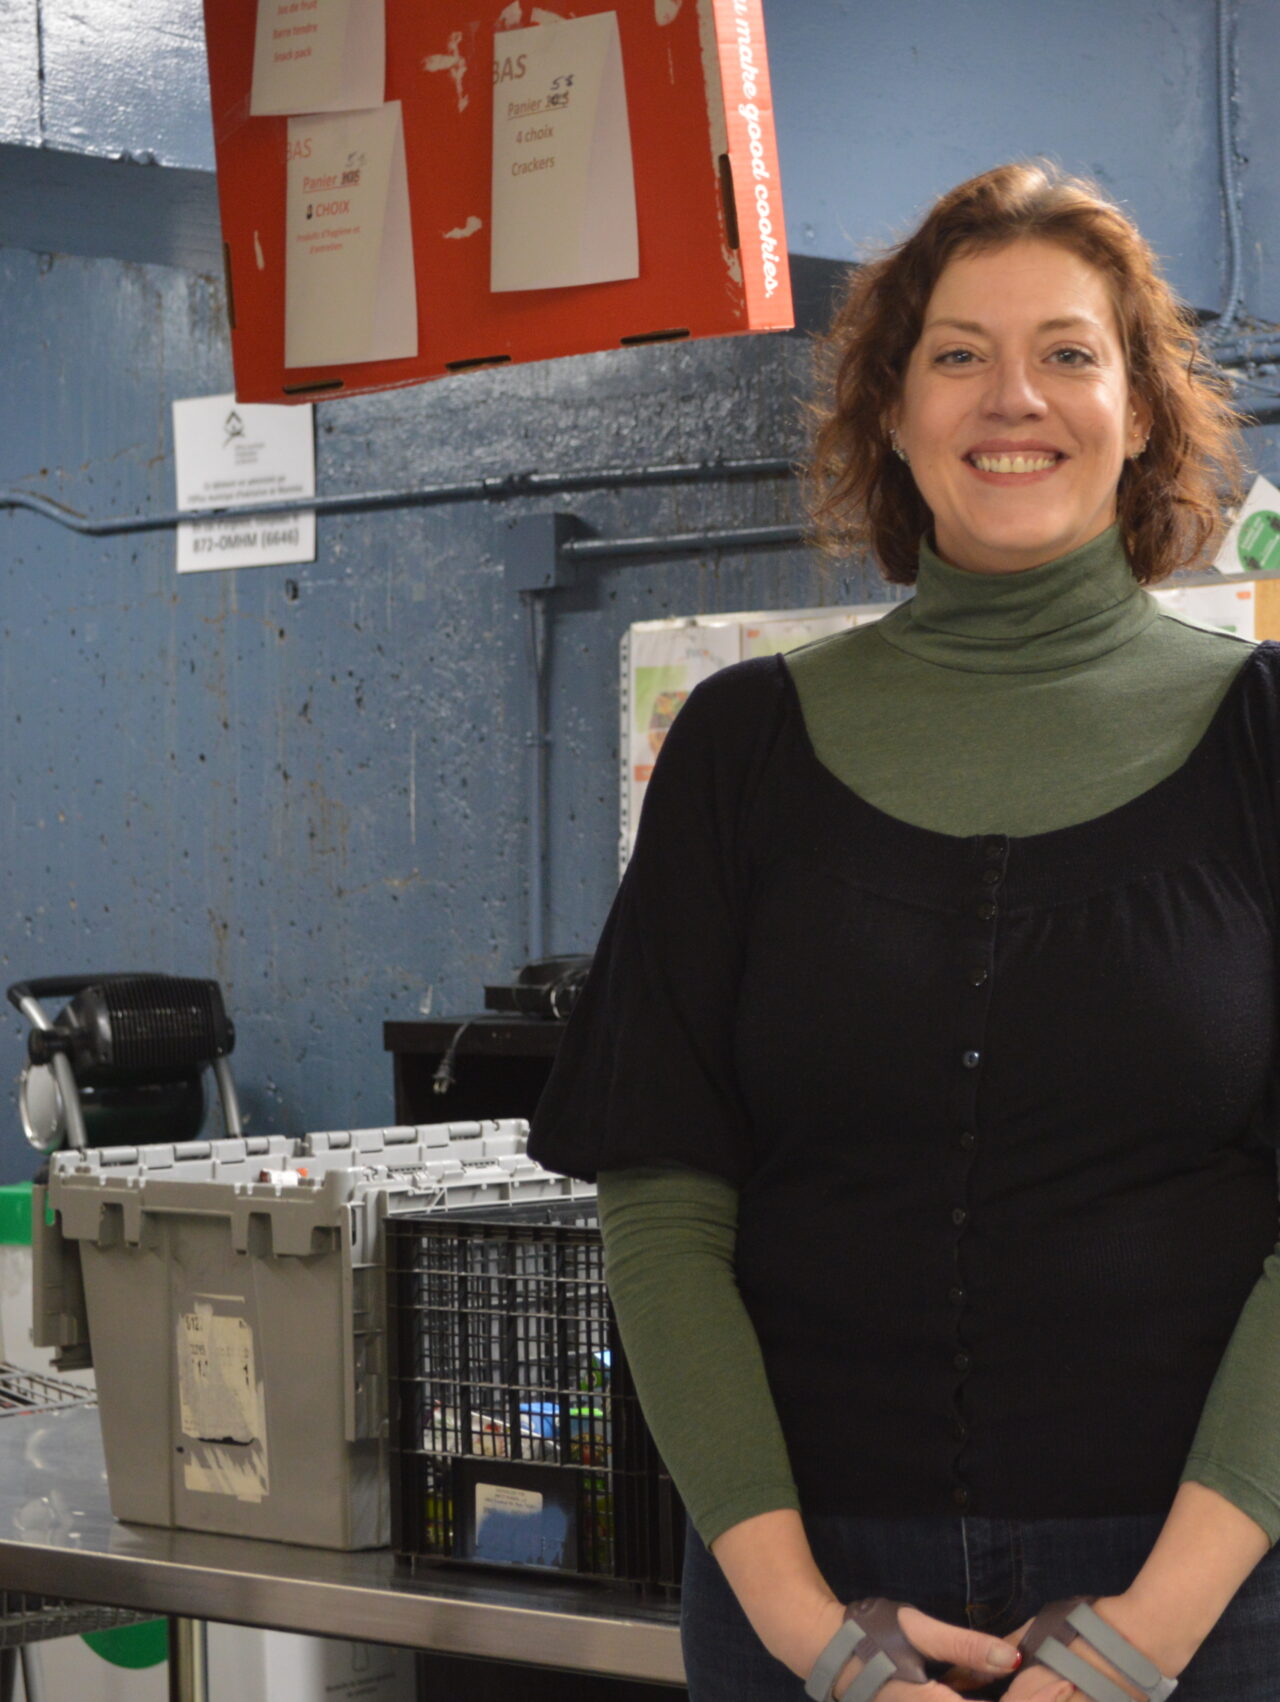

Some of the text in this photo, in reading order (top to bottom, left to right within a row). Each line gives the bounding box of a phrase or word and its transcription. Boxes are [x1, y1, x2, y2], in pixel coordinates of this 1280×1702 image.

[736, 18, 760, 98] make
[507, 99, 542, 116] Panier
[525, 125, 555, 142] choix
[738, 104, 771, 181] good
[511, 156, 556, 176] Crackers
[303, 173, 337, 191] Panier
[315, 200, 350, 218] CHOIX
[755, 183, 780, 298] cookies.
